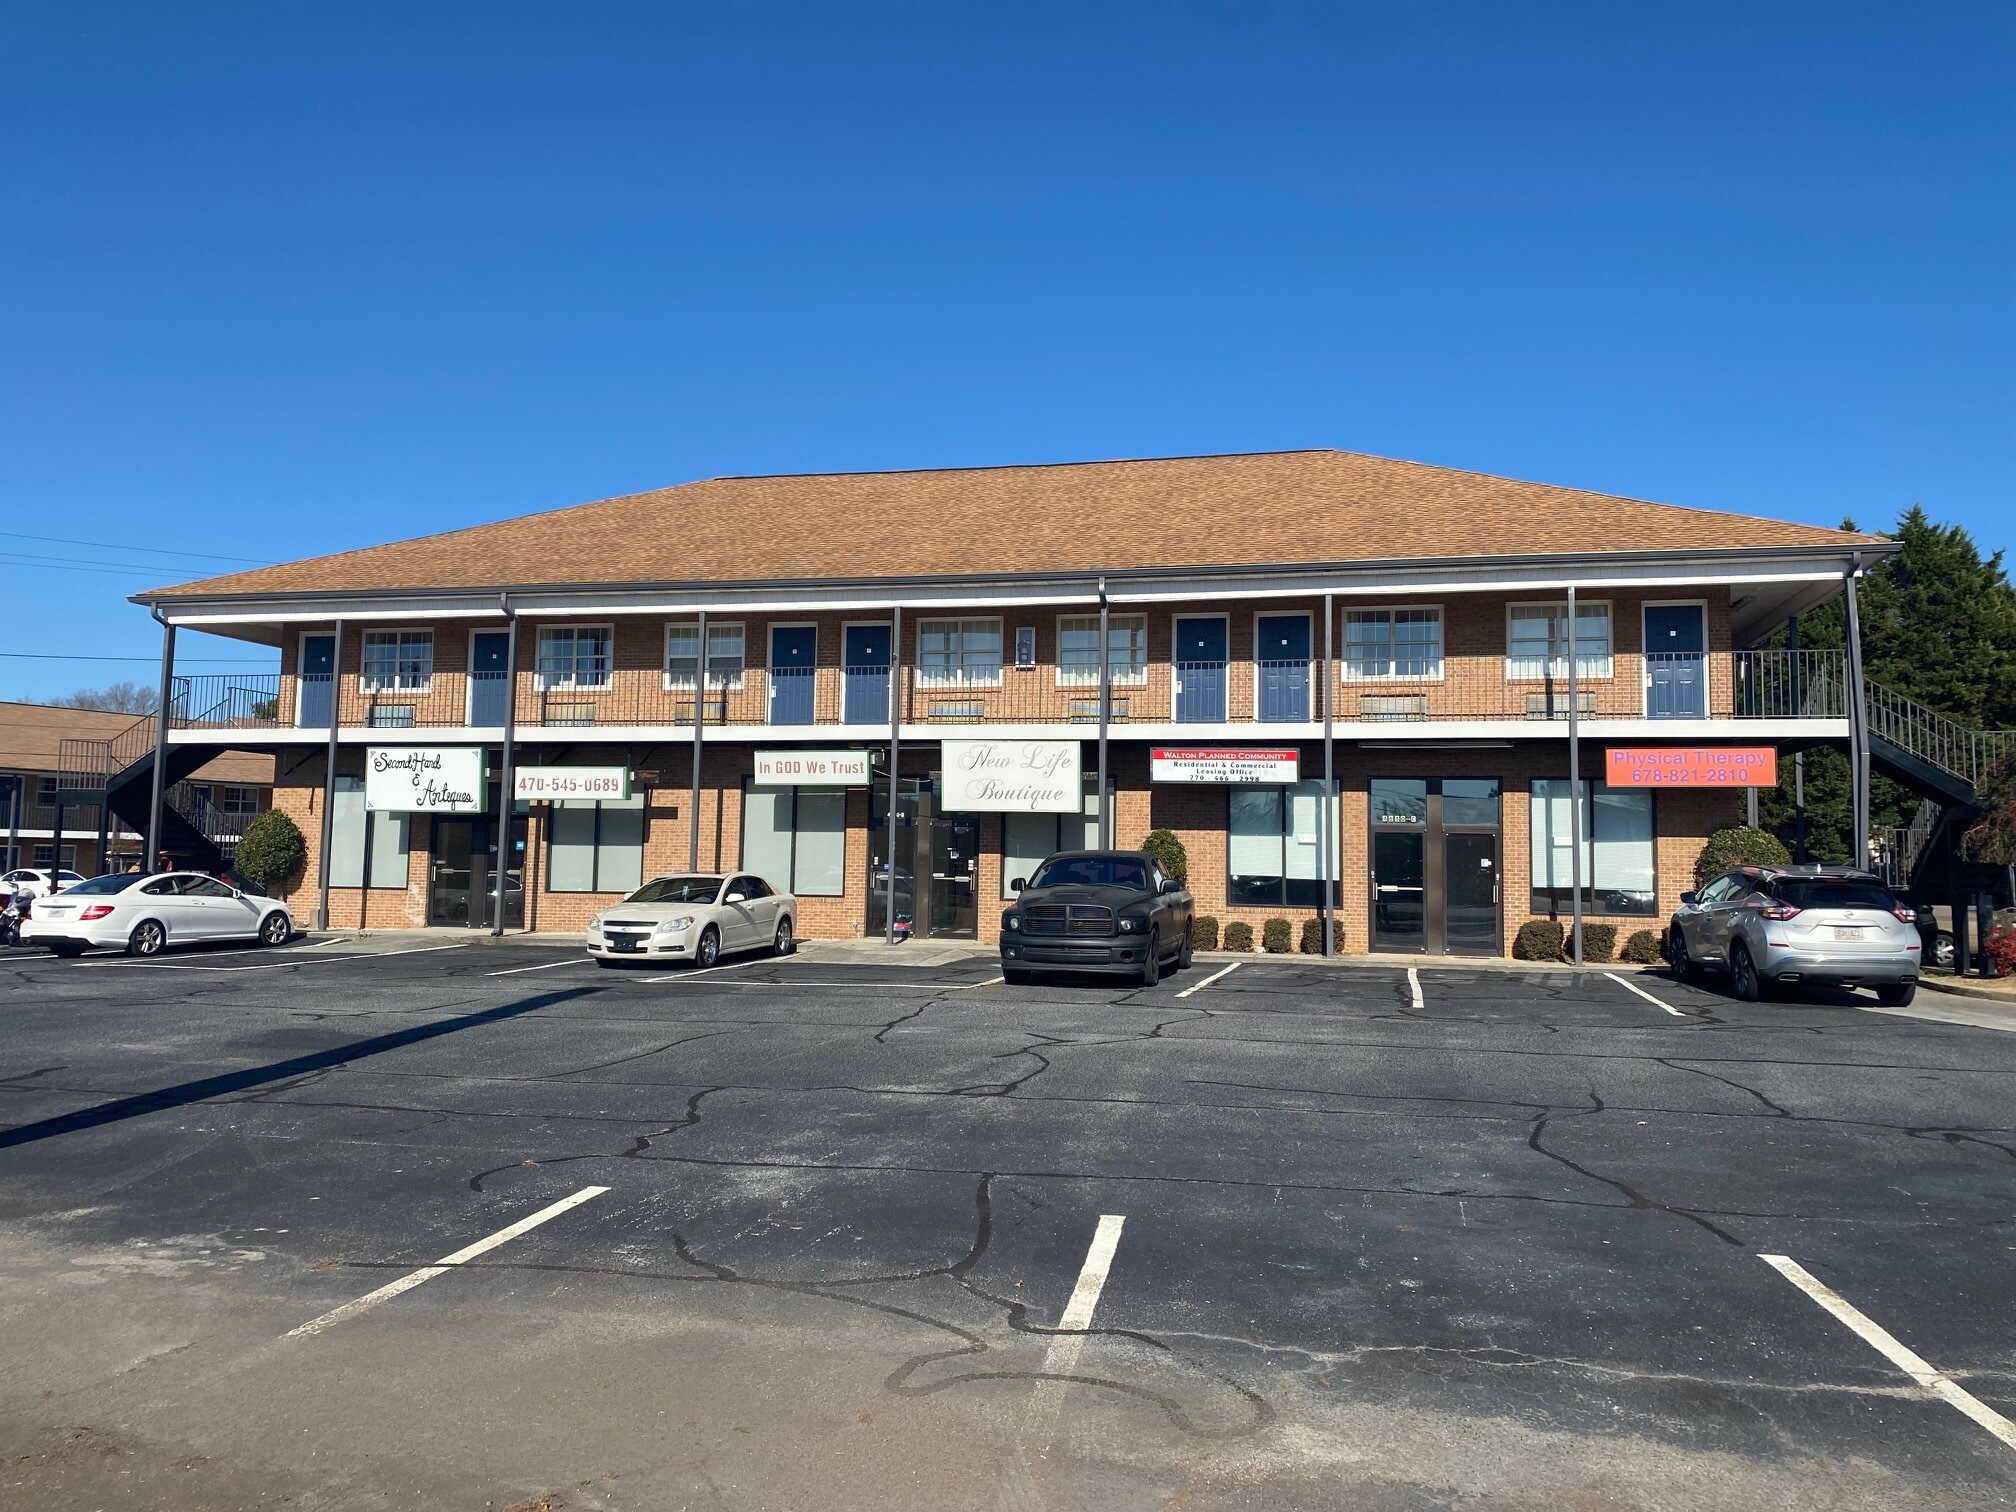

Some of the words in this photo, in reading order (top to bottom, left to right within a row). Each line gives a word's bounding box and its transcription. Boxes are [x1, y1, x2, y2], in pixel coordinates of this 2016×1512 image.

[958, 744, 1014, 770] New
[1020, 743, 1073, 779] Life
[1163, 751, 1197, 760] WALTON
[1199, 752, 1237, 760] PLANNED
[1238, 752, 1287, 760] COMMUNITY
[1613, 752, 1688, 768] Physical
[1693, 751, 1767, 768] Therapy
[759, 761, 771, 774] In
[775, 761, 801, 774] GOD
[806, 761, 826, 774] We
[831, 761, 865, 774] Trust
[1230, 761, 1277, 769] Commercial
[1632, 768, 1748, 782] 678-821-2810
[518, 777, 619, 791] 470-545-0689
[965, 778, 1067, 810] Boutique
